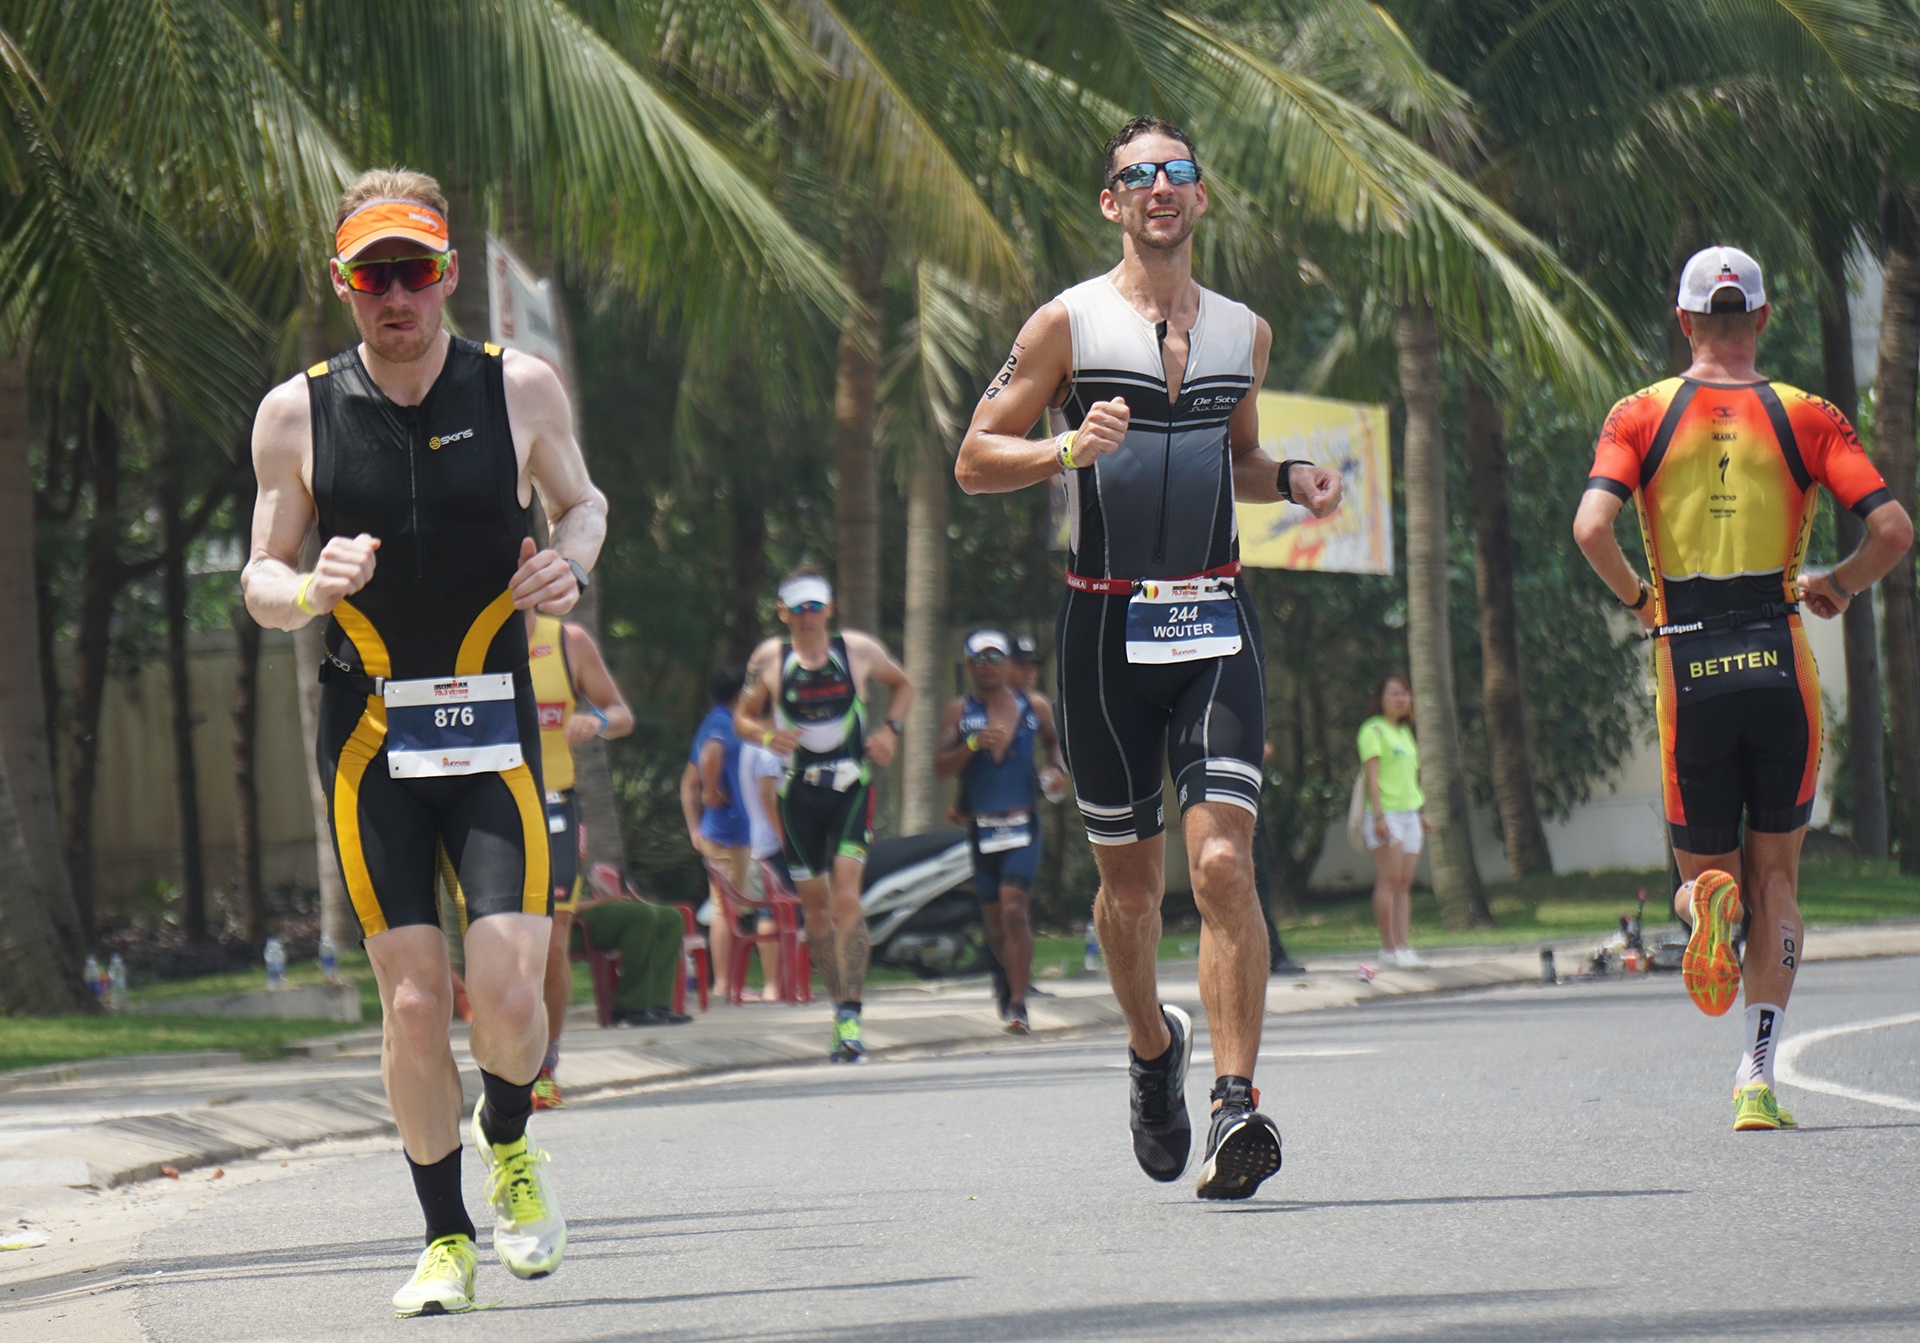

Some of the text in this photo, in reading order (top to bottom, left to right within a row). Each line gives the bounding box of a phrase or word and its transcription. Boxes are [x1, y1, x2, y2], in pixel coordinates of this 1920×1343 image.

[1193, 395, 1238, 406] De Soto
[1168, 605, 1199, 624] 244
[1152, 623, 1214, 639] WOUTER
[1689, 650, 1778, 678] BETTEN
[434, 706, 475, 728] 876
